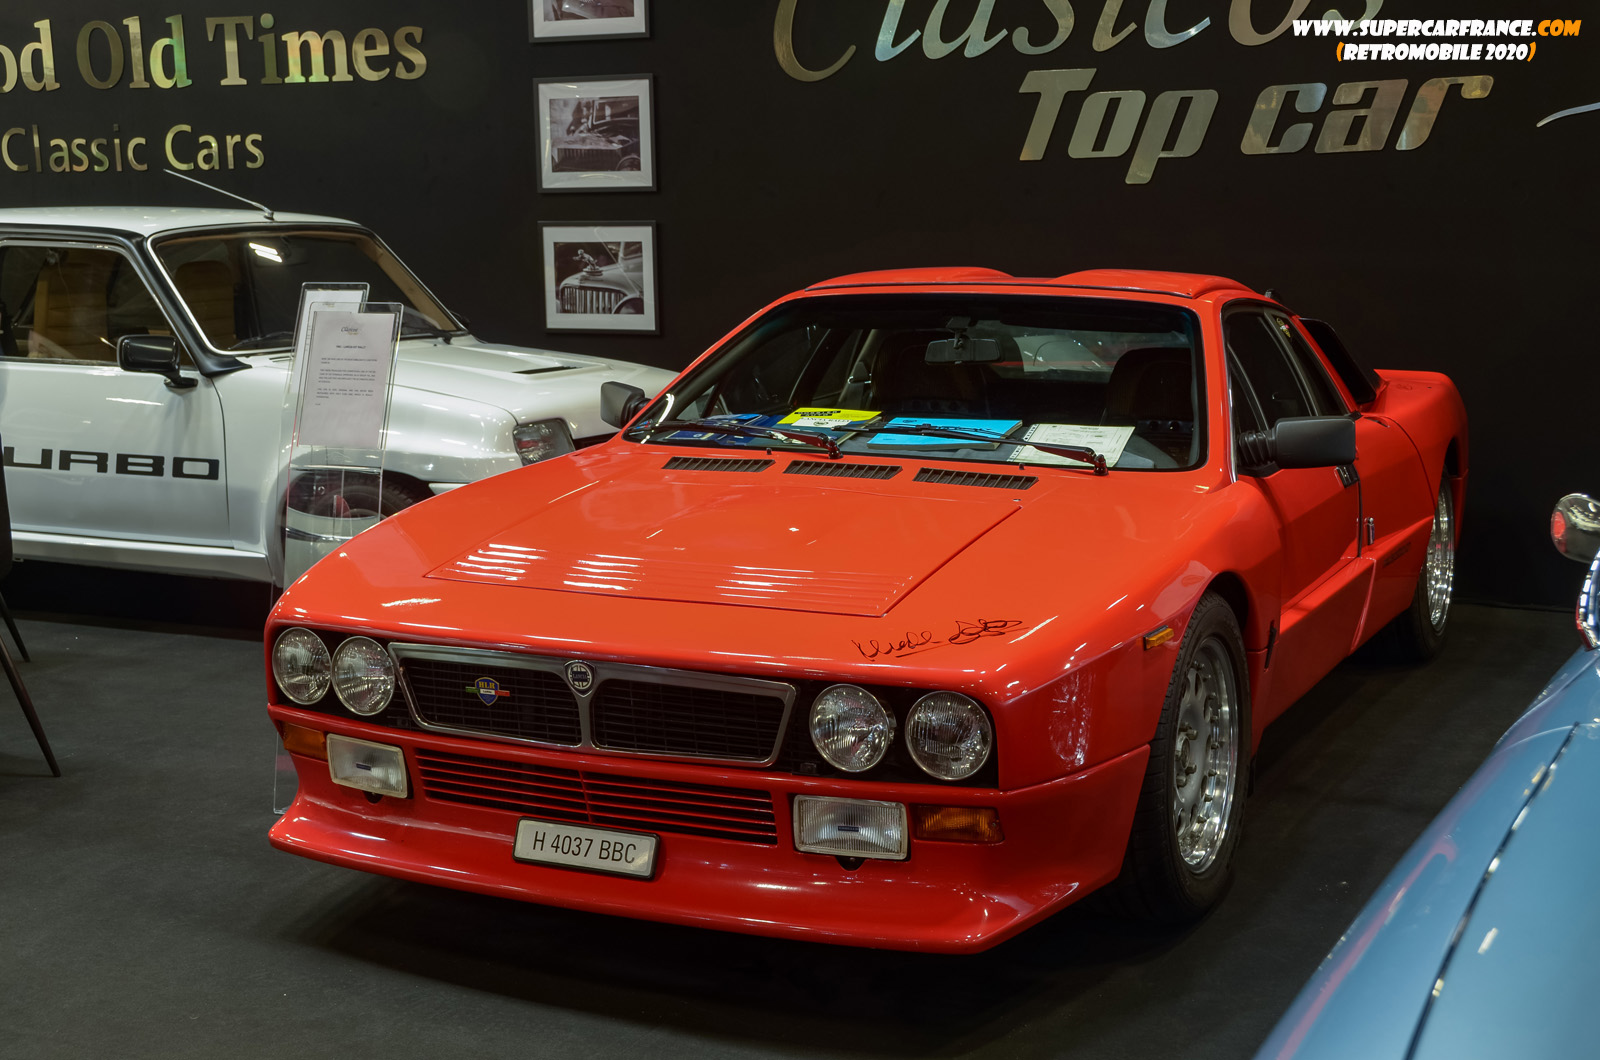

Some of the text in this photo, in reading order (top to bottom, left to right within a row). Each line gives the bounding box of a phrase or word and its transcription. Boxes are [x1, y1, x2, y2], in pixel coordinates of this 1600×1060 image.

[77, 14, 193, 89] Old
[205, 13, 428, 86] Times
[1, 124, 265, 172] Classic Cars
[1019, 68, 1494, 184] Top car
[4, 446, 220, 480] URBO
[532, 831, 637, 864] H 4037 BBC
